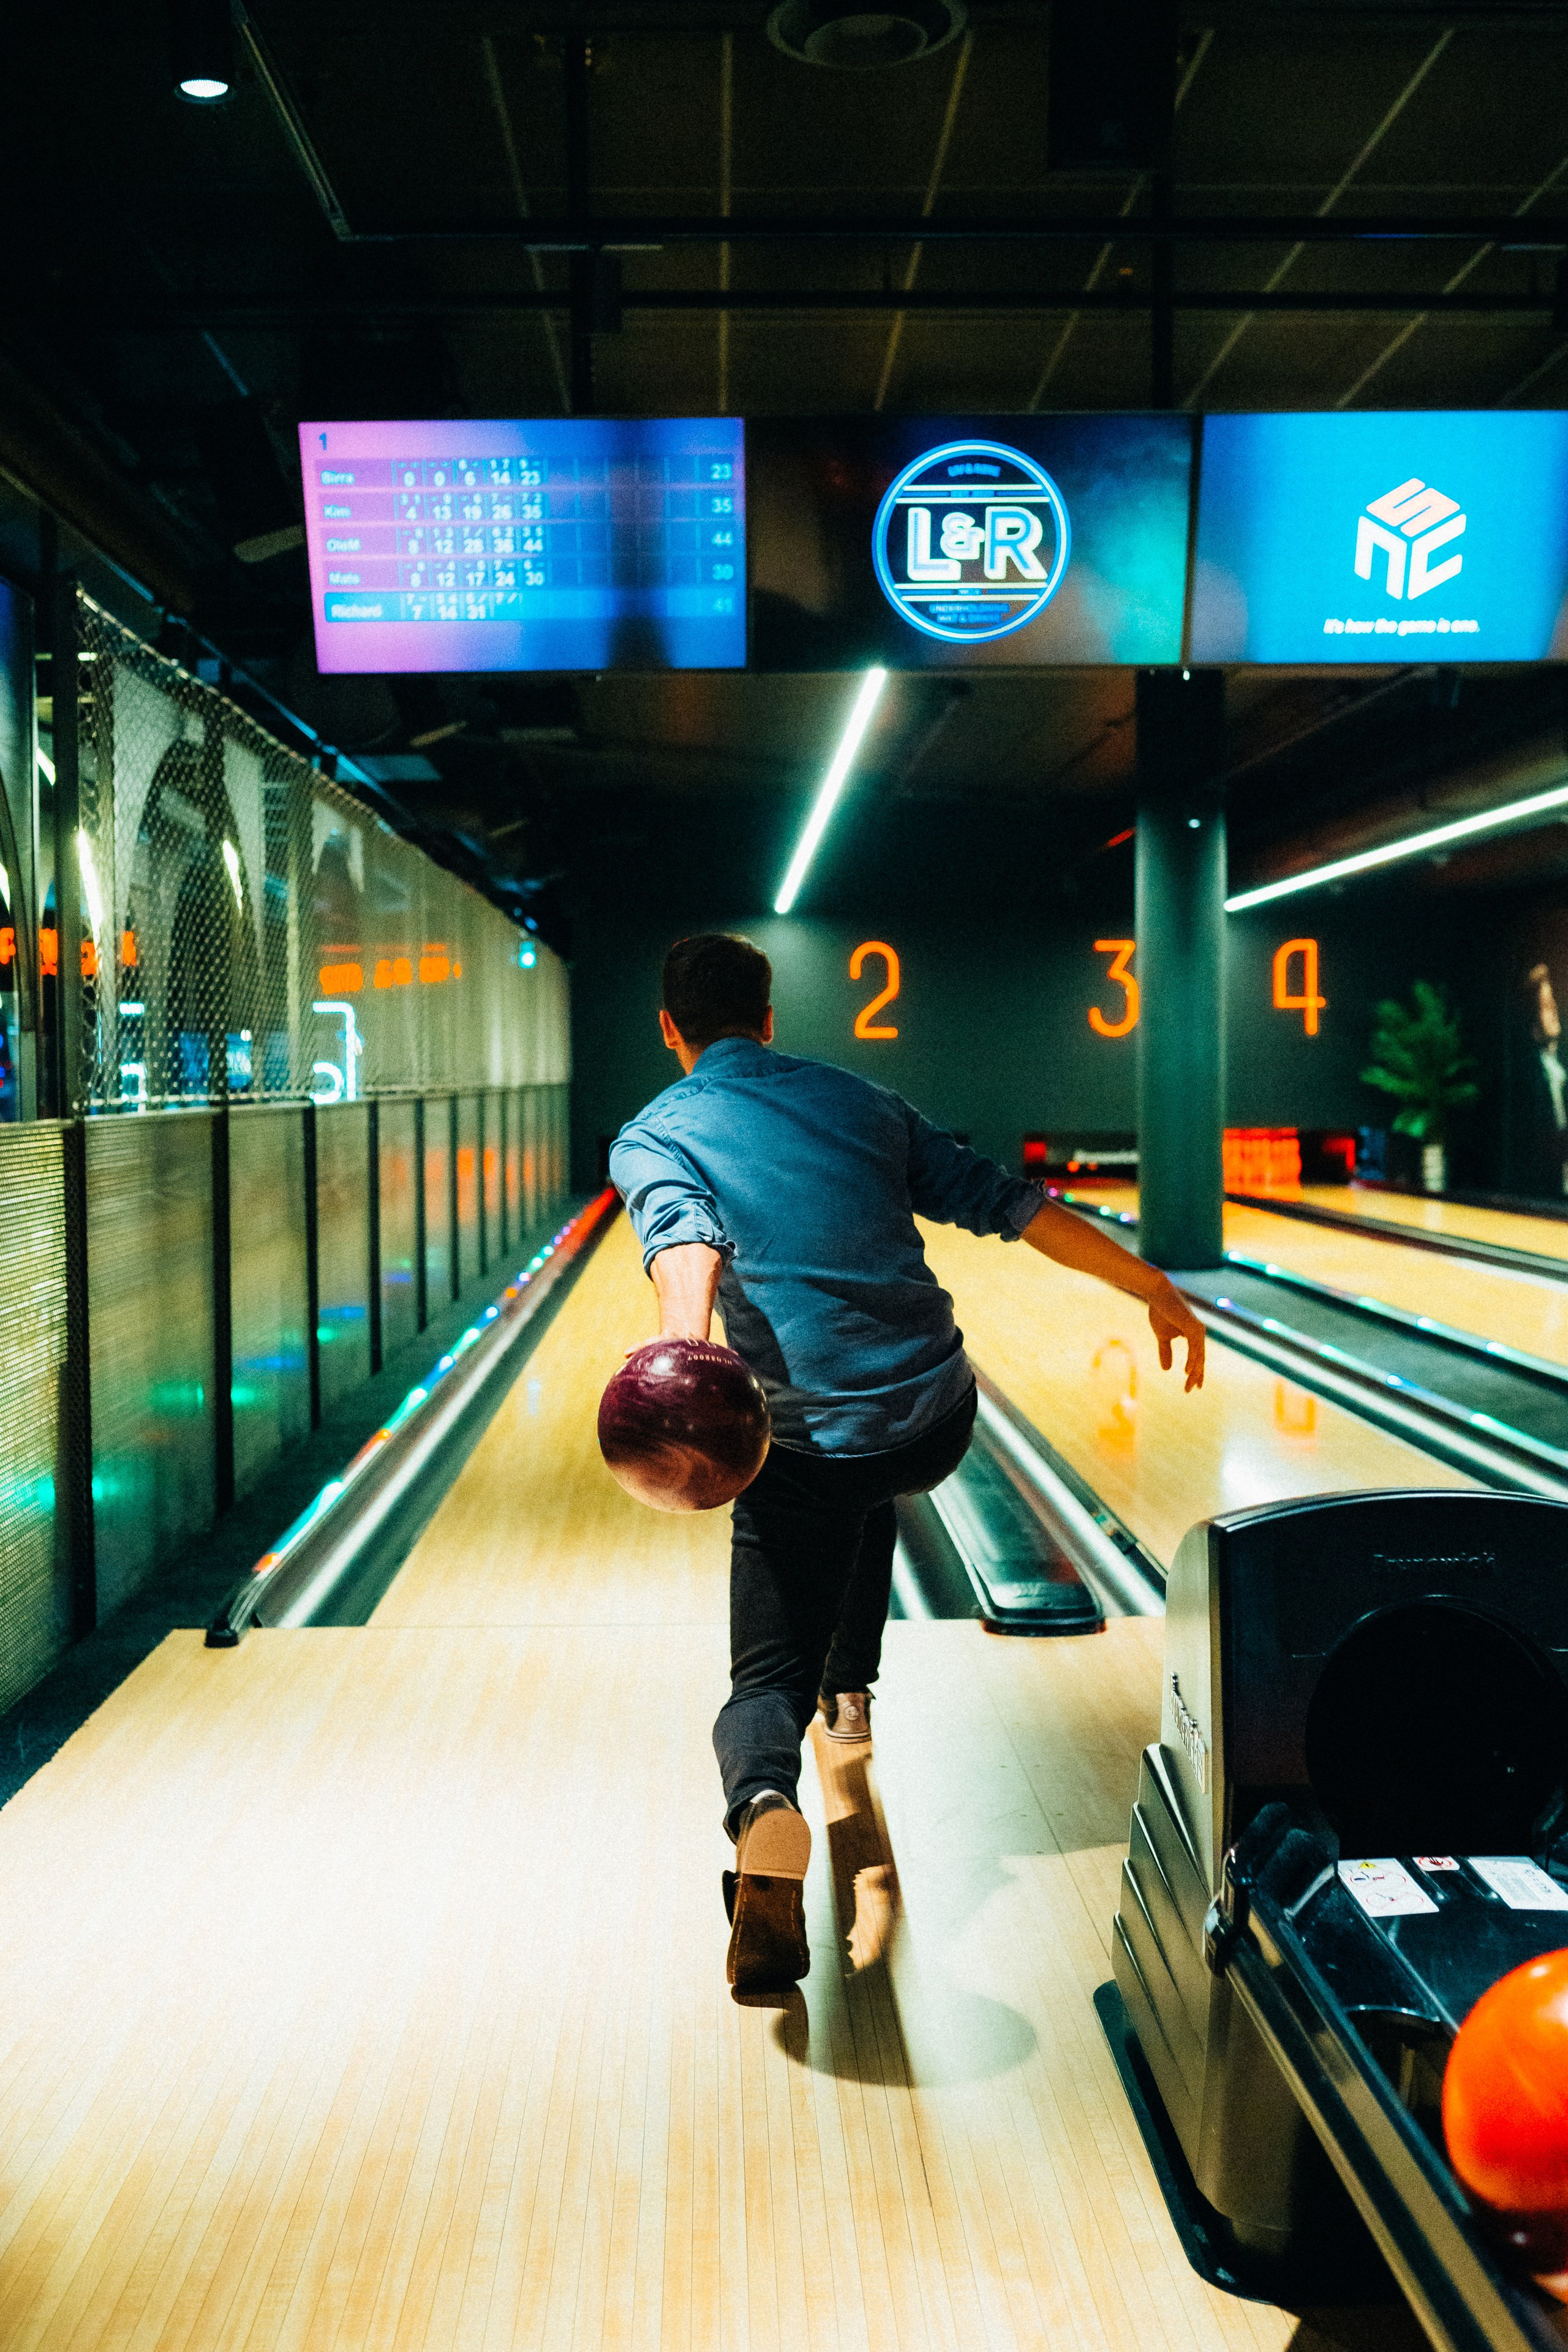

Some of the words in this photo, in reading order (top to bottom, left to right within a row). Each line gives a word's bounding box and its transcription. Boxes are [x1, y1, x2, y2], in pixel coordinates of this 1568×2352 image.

[318, 433, 327, 450] 1
[404, 470, 415, 487] 0
[434, 470, 445, 487] 0
[464, 470, 476, 487] 6
[491, 470, 510, 486] 14
[521, 470, 541, 486] 23
[711, 463, 733, 480] 23
[405, 505, 418, 521] 4
[432, 505, 452, 521] 13
[462, 505, 482, 521] 19
[492, 504, 513, 520] 26
[522, 503, 542, 519] 35
[712, 497, 733, 513] 35
[434, 538, 454, 554] 12
[464, 538, 484, 554] 28
[494, 538, 514, 553] 36
[524, 537, 543, 552] 44
[712, 531, 733, 546] 44
[907, 506, 1048, 581] L&R
[437, 572, 455, 587] 12
[466, 571, 485, 587] 17
[495, 571, 515, 586] 24
[526, 571, 545, 586] 30
[712, 564, 734, 581] 30
[412, 605, 423, 620] 7
[438, 605, 458, 620] 14
[467, 604, 486, 619] 31
[850, 941, 900, 1038] 2
[1088, 940, 1140, 1038] 3
[1272, 938, 1327, 1036] 4
